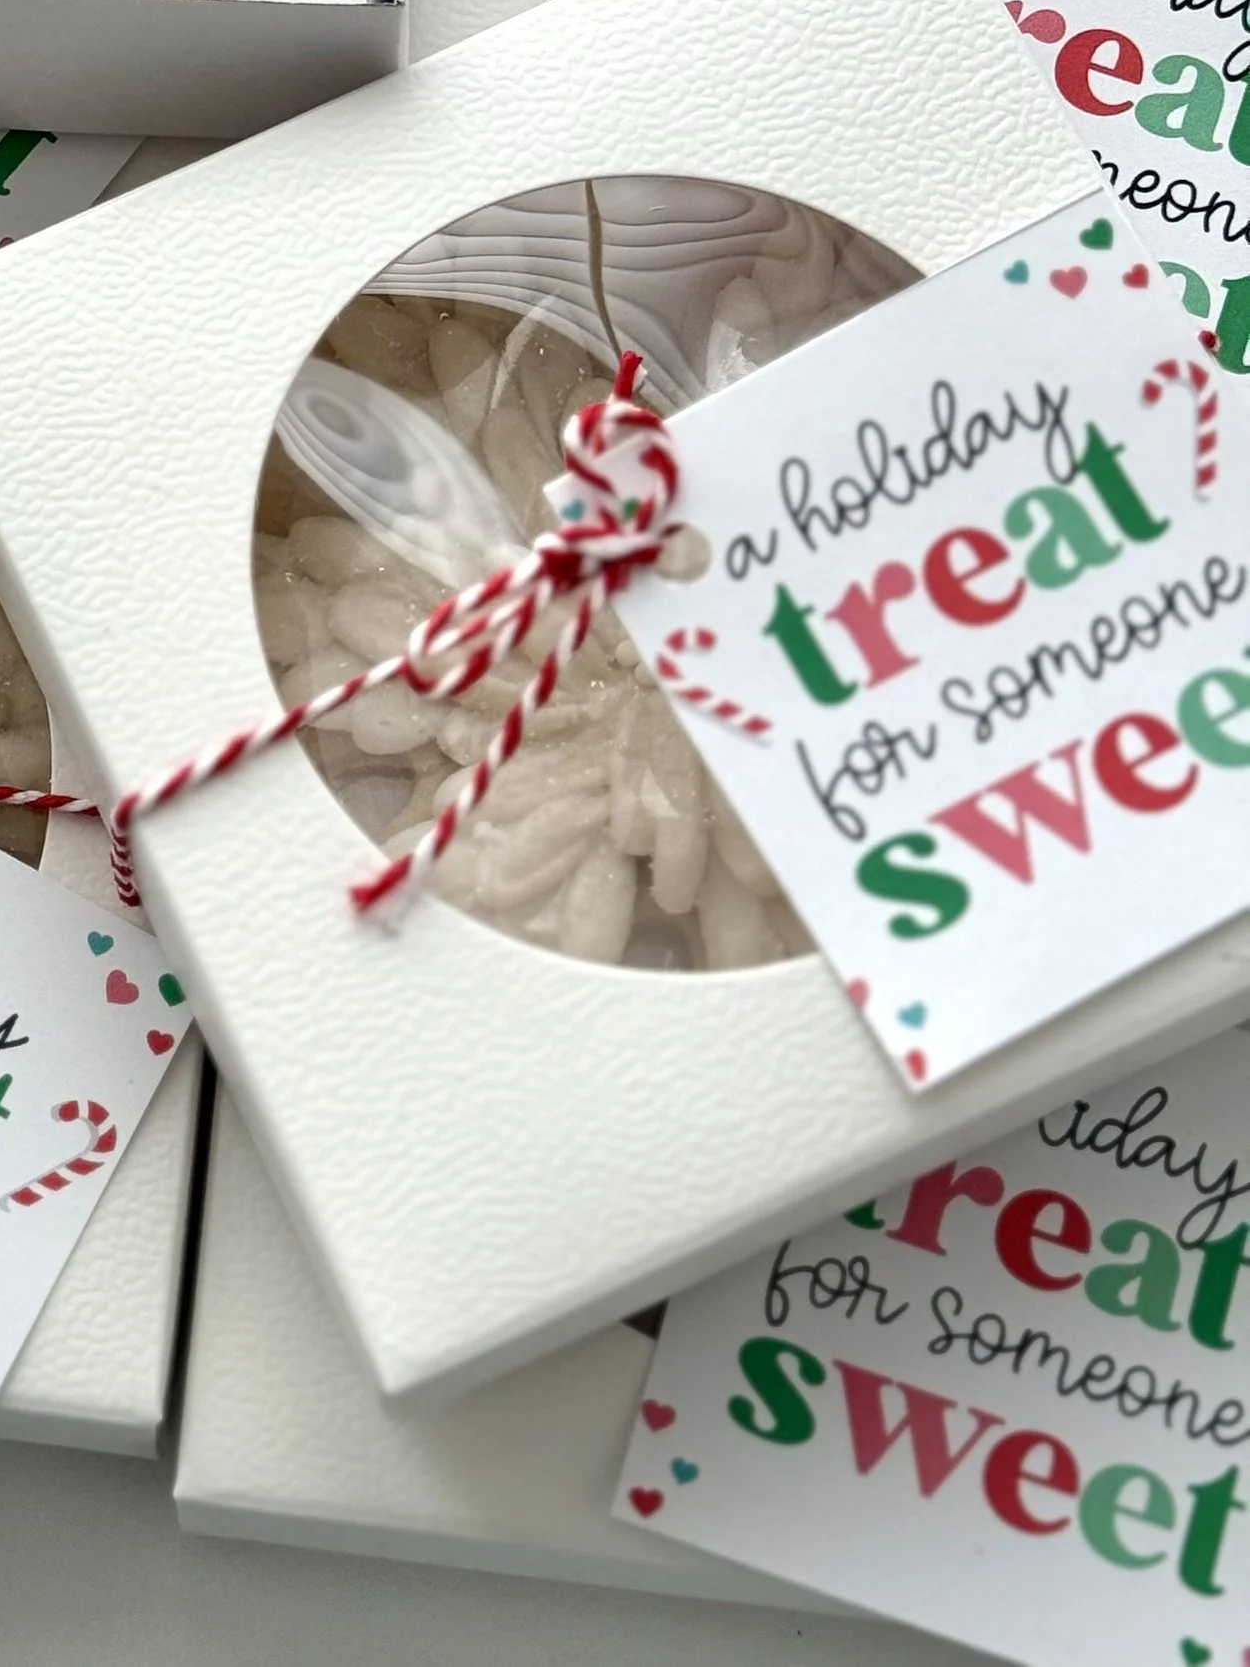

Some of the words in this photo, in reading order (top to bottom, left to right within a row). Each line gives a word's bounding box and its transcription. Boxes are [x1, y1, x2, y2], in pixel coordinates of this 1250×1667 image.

[726, 524, 778, 581] a
[779, 380, 1069, 554] holiday
[761, 421, 1172, 708] treat
[796, 721, 938, 843] for
[941, 556, 1248, 743] someone
[856, 647, 1250, 941] swee
[727, 1336, 1247, 1597] sweet
[764, 1239, 910, 1328] for
[927, 1286, 1250, 1447] someone
